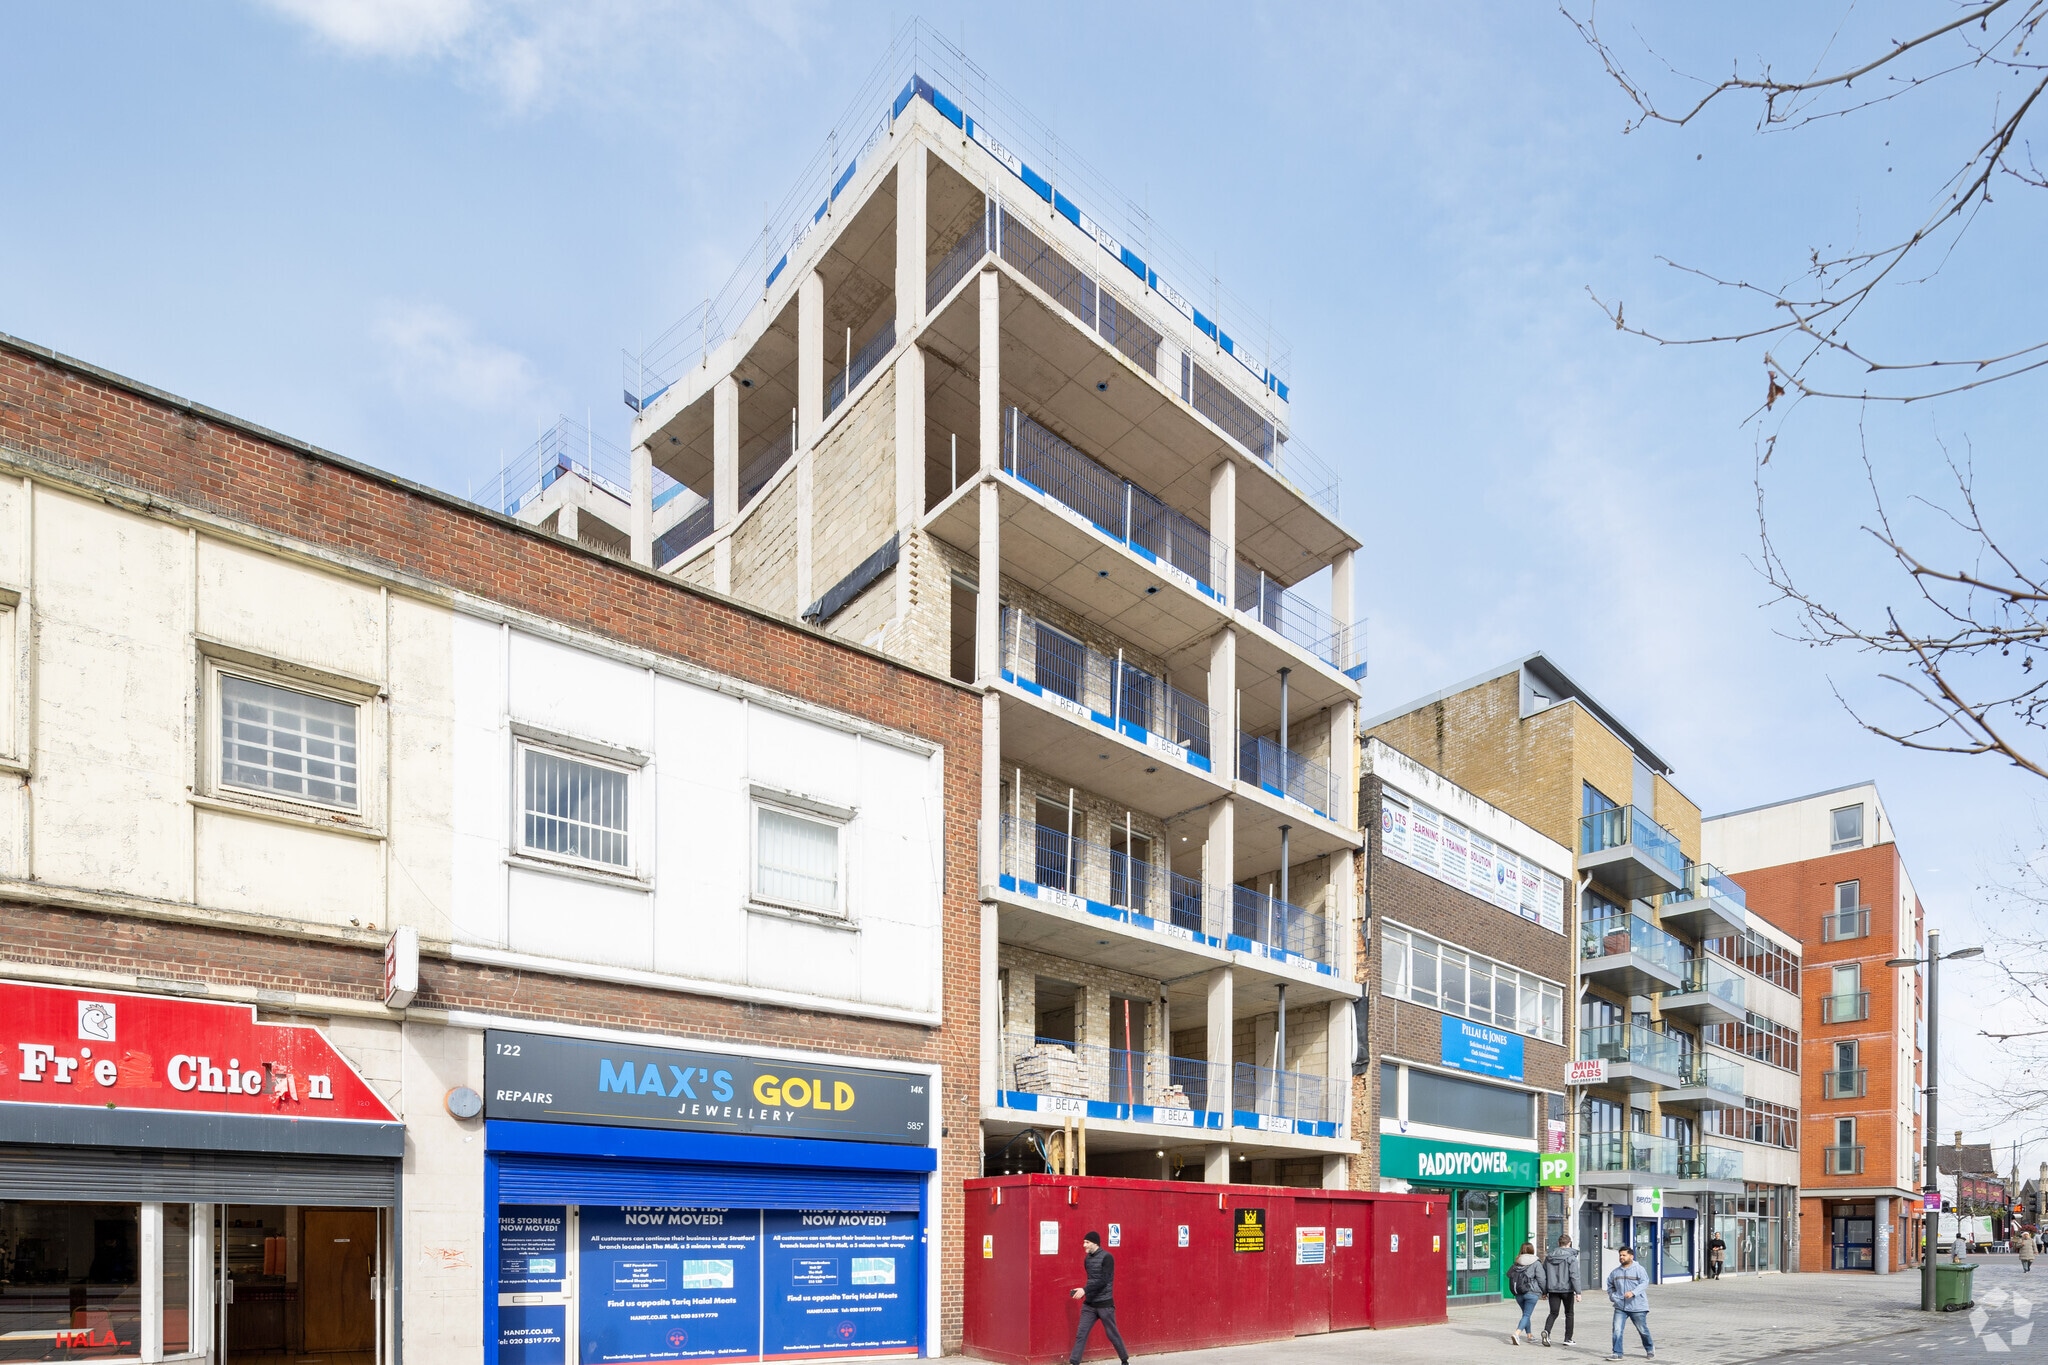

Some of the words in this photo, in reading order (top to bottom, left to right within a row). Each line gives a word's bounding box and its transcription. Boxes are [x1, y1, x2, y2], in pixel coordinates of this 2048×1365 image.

[867, 125, 884, 153] BELA
[991, 139, 1015, 167] BELA
[1170, 289, 1187, 312] BELA
[1245, 354, 1261, 373] BELA
[1161, 742, 1182, 759] BELA
[1395, 812, 1406, 826] LTS
[1413, 822, 1438, 842] EARNING
[1506, 868, 1516, 881] LTA
[1168, 925, 1187, 939] BELA
[1462, 1023, 1481, 1038] PILLAI
[1482, 1029, 1488, 1040] &
[1489, 1030, 1507, 1045] JONES
[496, 1043, 521, 1057] 122
[1574, 1060, 1599, 1070] MINI
[1571, 1069, 1601, 1079] CABS
[599, 1058, 734, 1103] MAX'S
[753, 1074, 855, 1111] GOLD
[910, 1085, 924, 1094] 14K
[496, 1090, 553, 1104] REPAIRS
[1055, 1098, 1080, 1112] BELA
[678, 1103, 794, 1122] JEWELLERY
[1168, 1109, 1189, 1122] BELA
[1271, 1117, 1288, 1129] BELA
[625, 1214, 664, 1225] NOW
[668, 1214, 723, 1225] MOVED!
[802, 1215, 836, 1225] NOW
[839, 1216, 886, 1225] MOVED!
[637, 1299, 670, 1308] opposite
[672, 1298, 691, 1306] Tariq
[812, 1294, 841, 1302] opposite
[842, 1293, 859, 1301] Tariq
[56, 1330, 131, 1348] HALA
[504, 1328, 553, 1336] HANDT.CO.UK
